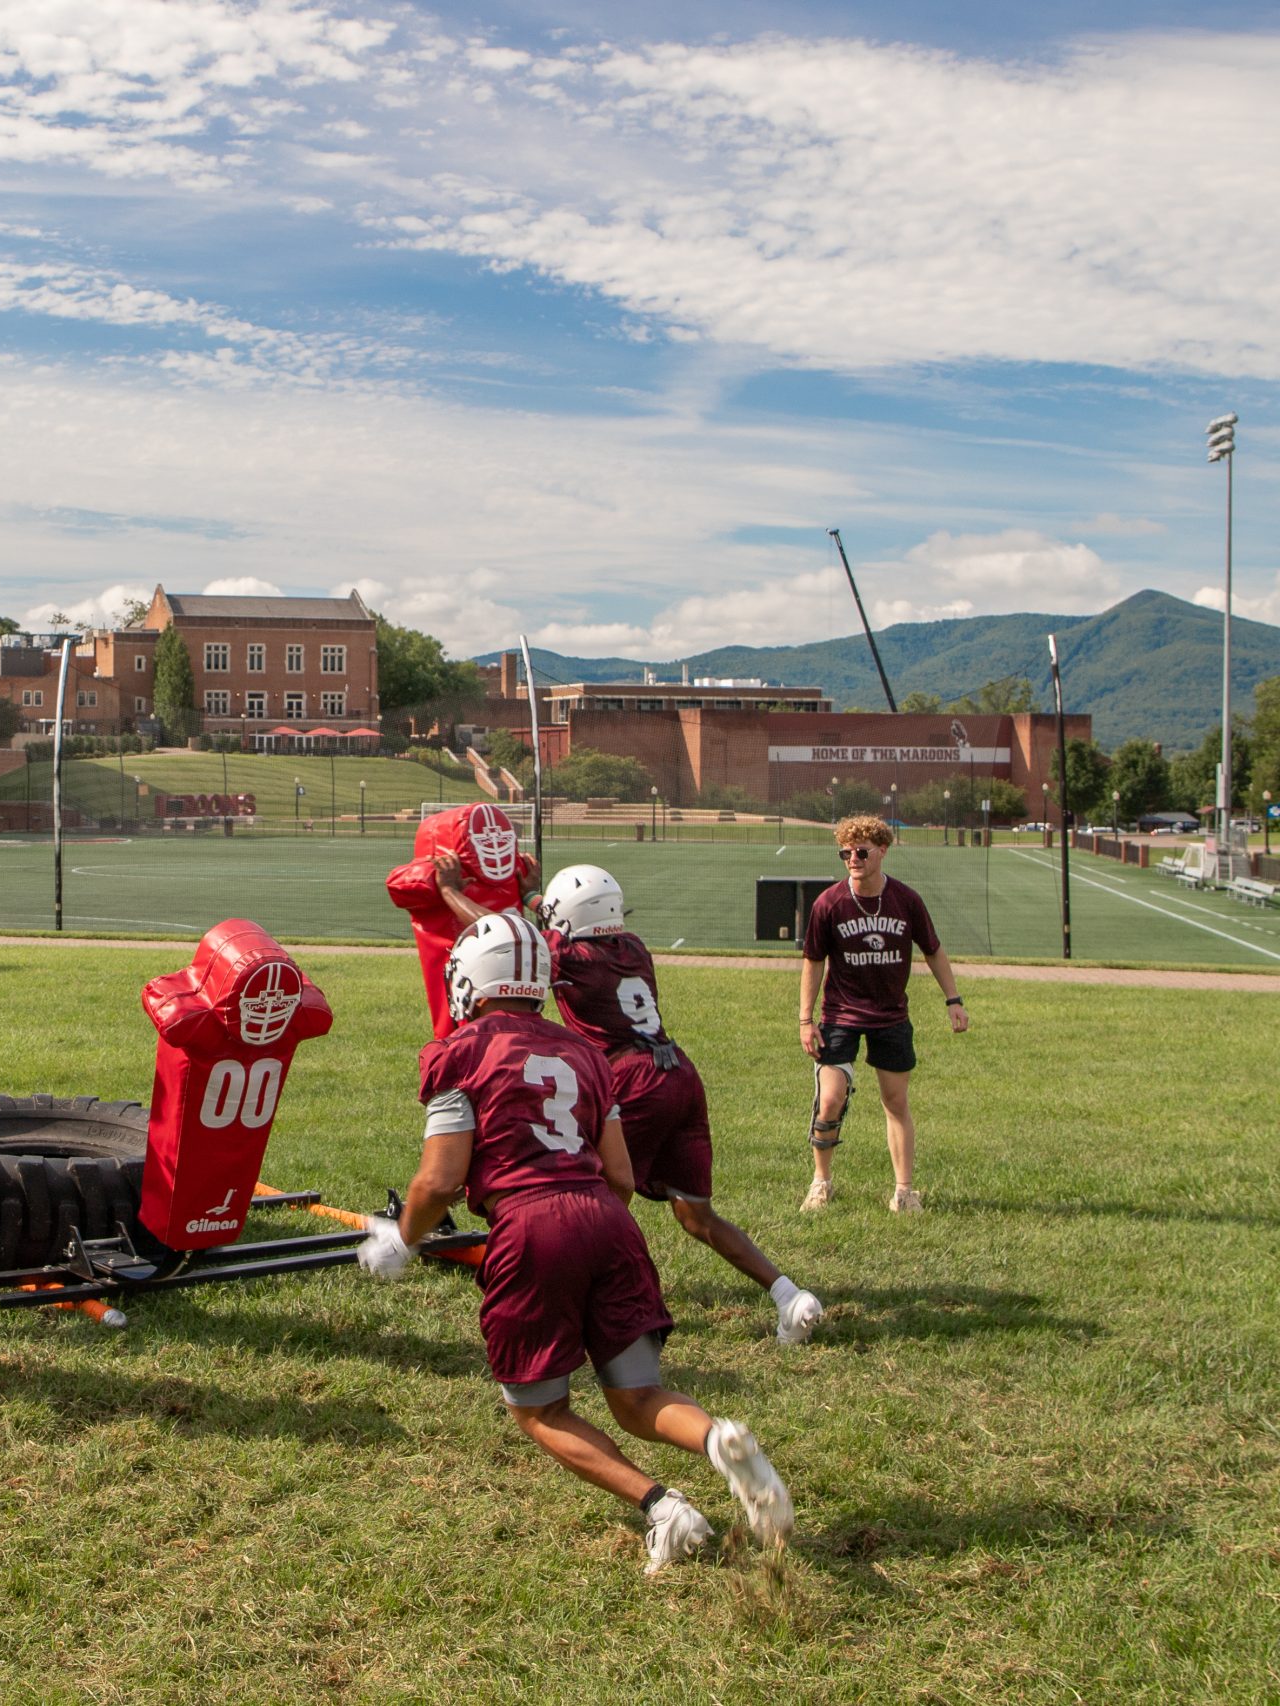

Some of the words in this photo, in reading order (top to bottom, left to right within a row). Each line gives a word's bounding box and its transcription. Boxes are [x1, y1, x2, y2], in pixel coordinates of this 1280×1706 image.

[811, 747, 849, 761] HOME
[851, 747, 867, 761] OF
[870, 747, 897, 761] THE
[899, 748, 960, 761] MAROONS
[836, 916, 907, 938] ROANOKE
[843, 949, 903, 966] FOOTBALL
[498, 984, 545, 999] Riddell
[616, 976, 661, 1035] 9
[199, 1058, 283, 1129] 00
[523, 1053, 585, 1155] 3
[185, 1217, 238, 1234] Gilman
